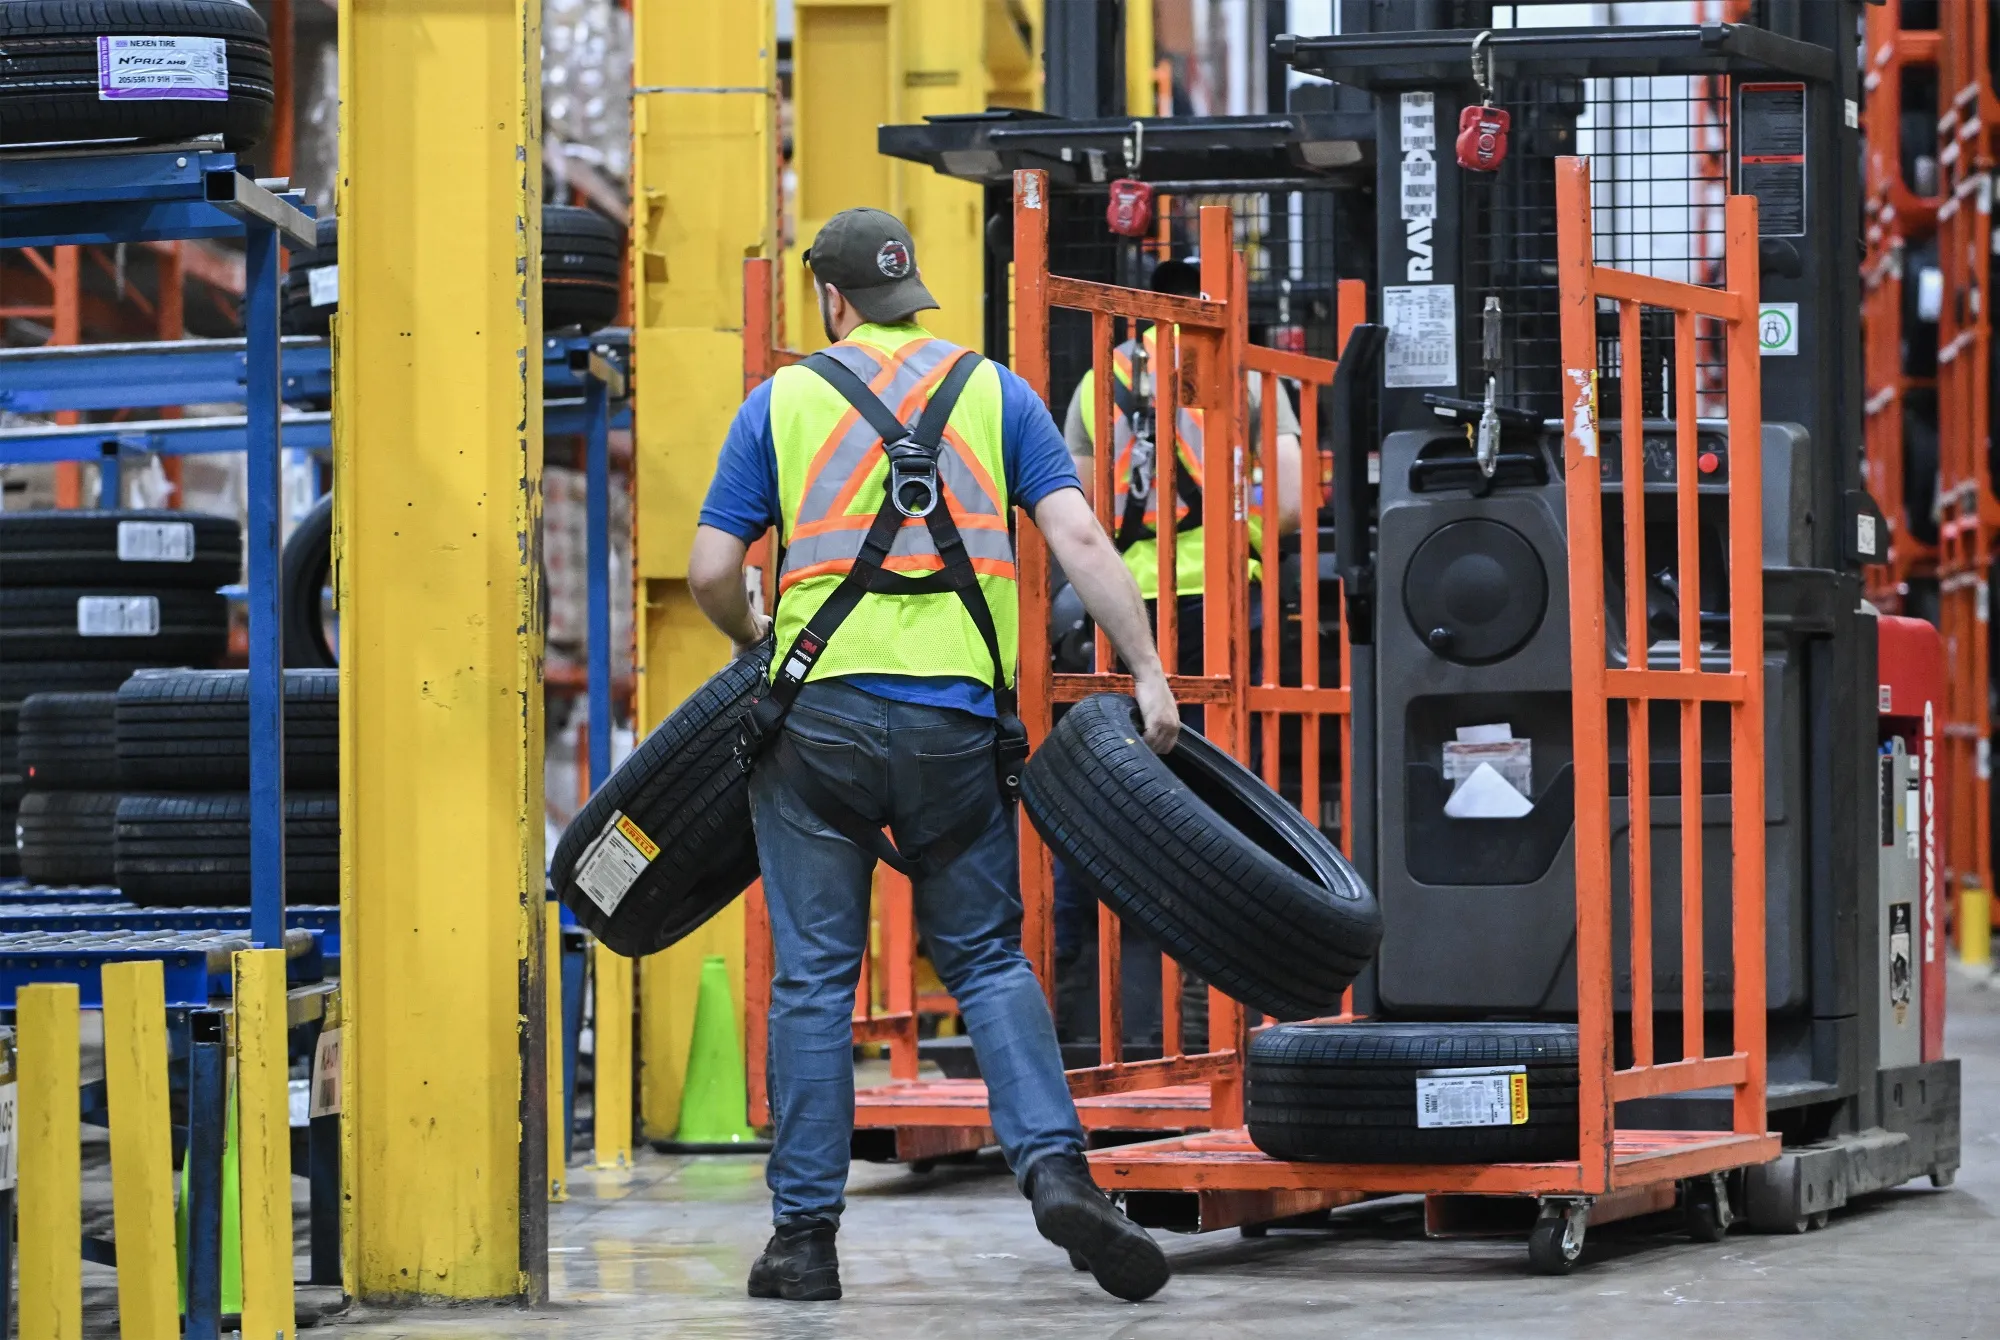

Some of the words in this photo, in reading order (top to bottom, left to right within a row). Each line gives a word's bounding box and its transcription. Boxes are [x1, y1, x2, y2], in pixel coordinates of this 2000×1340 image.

[801, 639, 818, 654] 3M
[621, 819, 656, 855] PIRELLI
[1924, 700, 1935, 962] RAYMOND
[1515, 1078, 1525, 1120] PIRELLI
